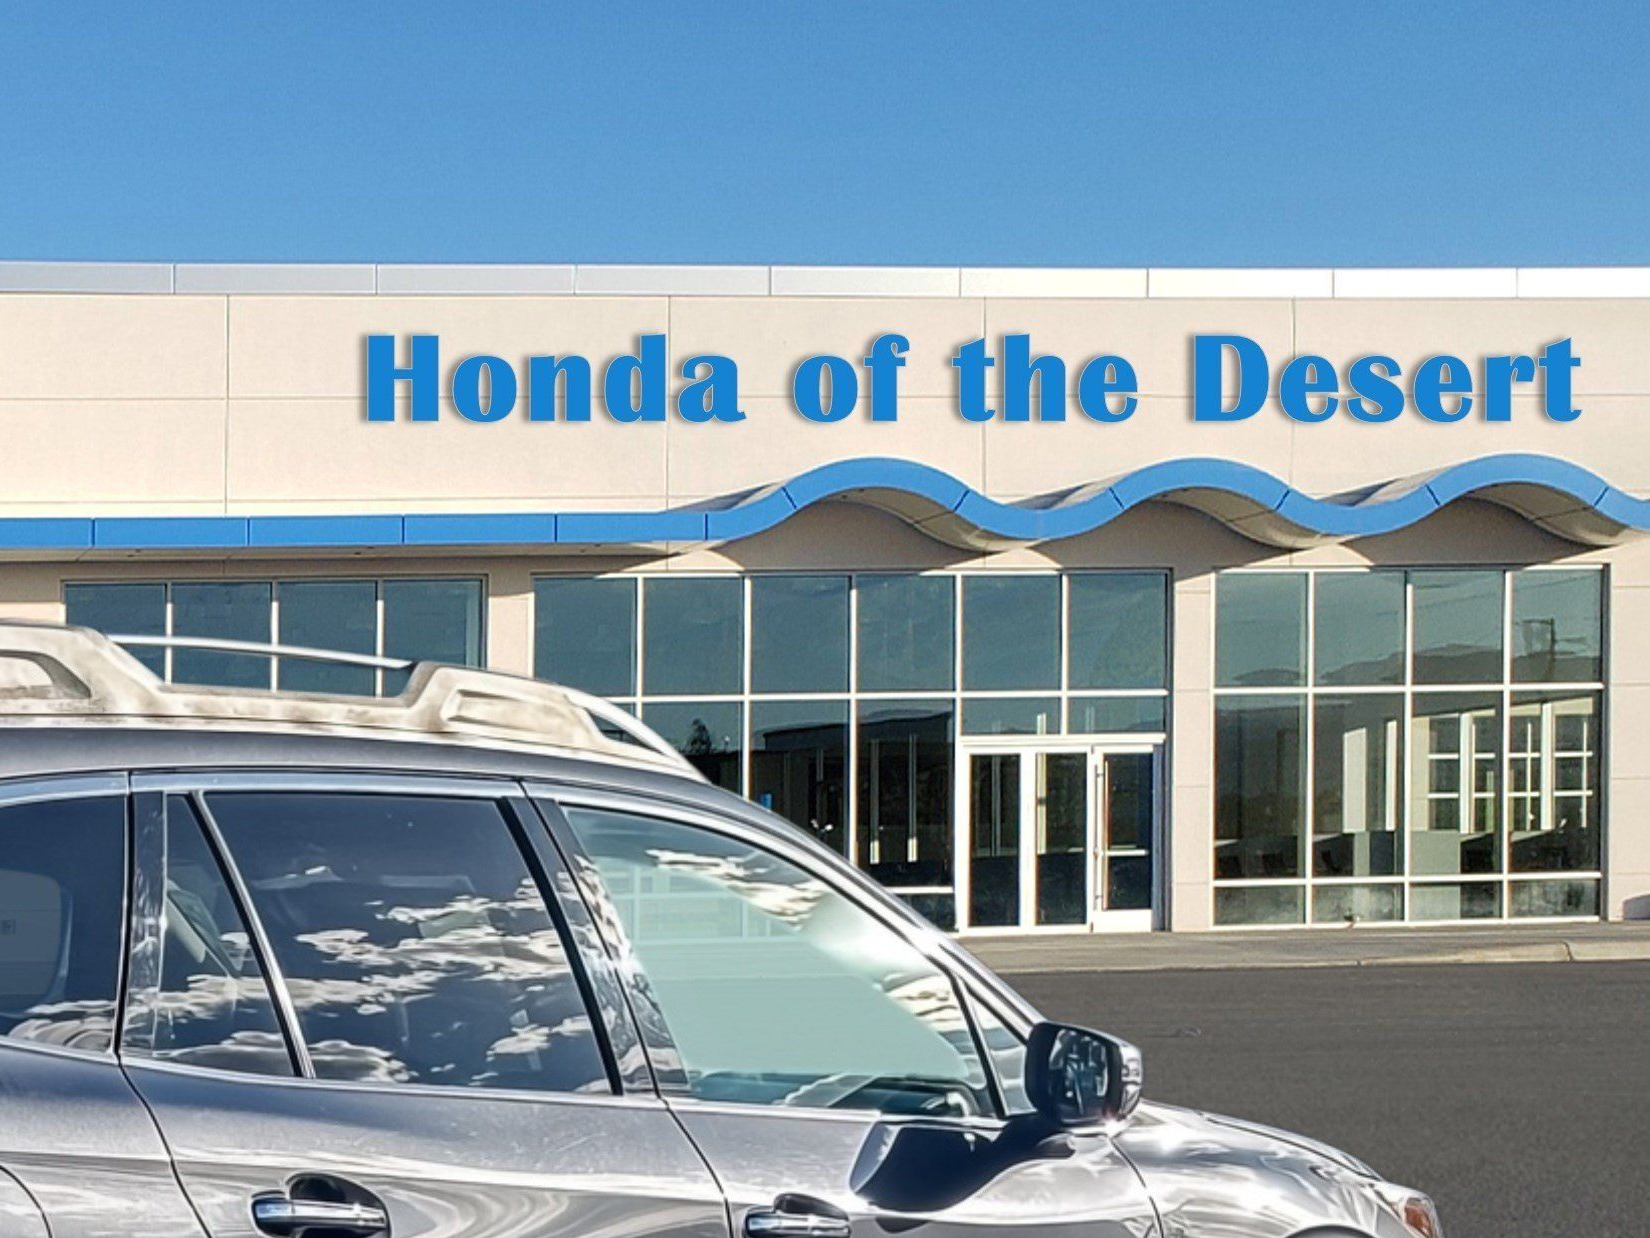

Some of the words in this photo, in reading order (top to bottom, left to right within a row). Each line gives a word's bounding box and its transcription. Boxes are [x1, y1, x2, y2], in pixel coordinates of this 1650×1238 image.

[366, 333, 747, 423] Honda
[793, 333, 911, 423] of
[951, 333, 1139, 422] the
[1193, 335, 1583, 422] Desert
